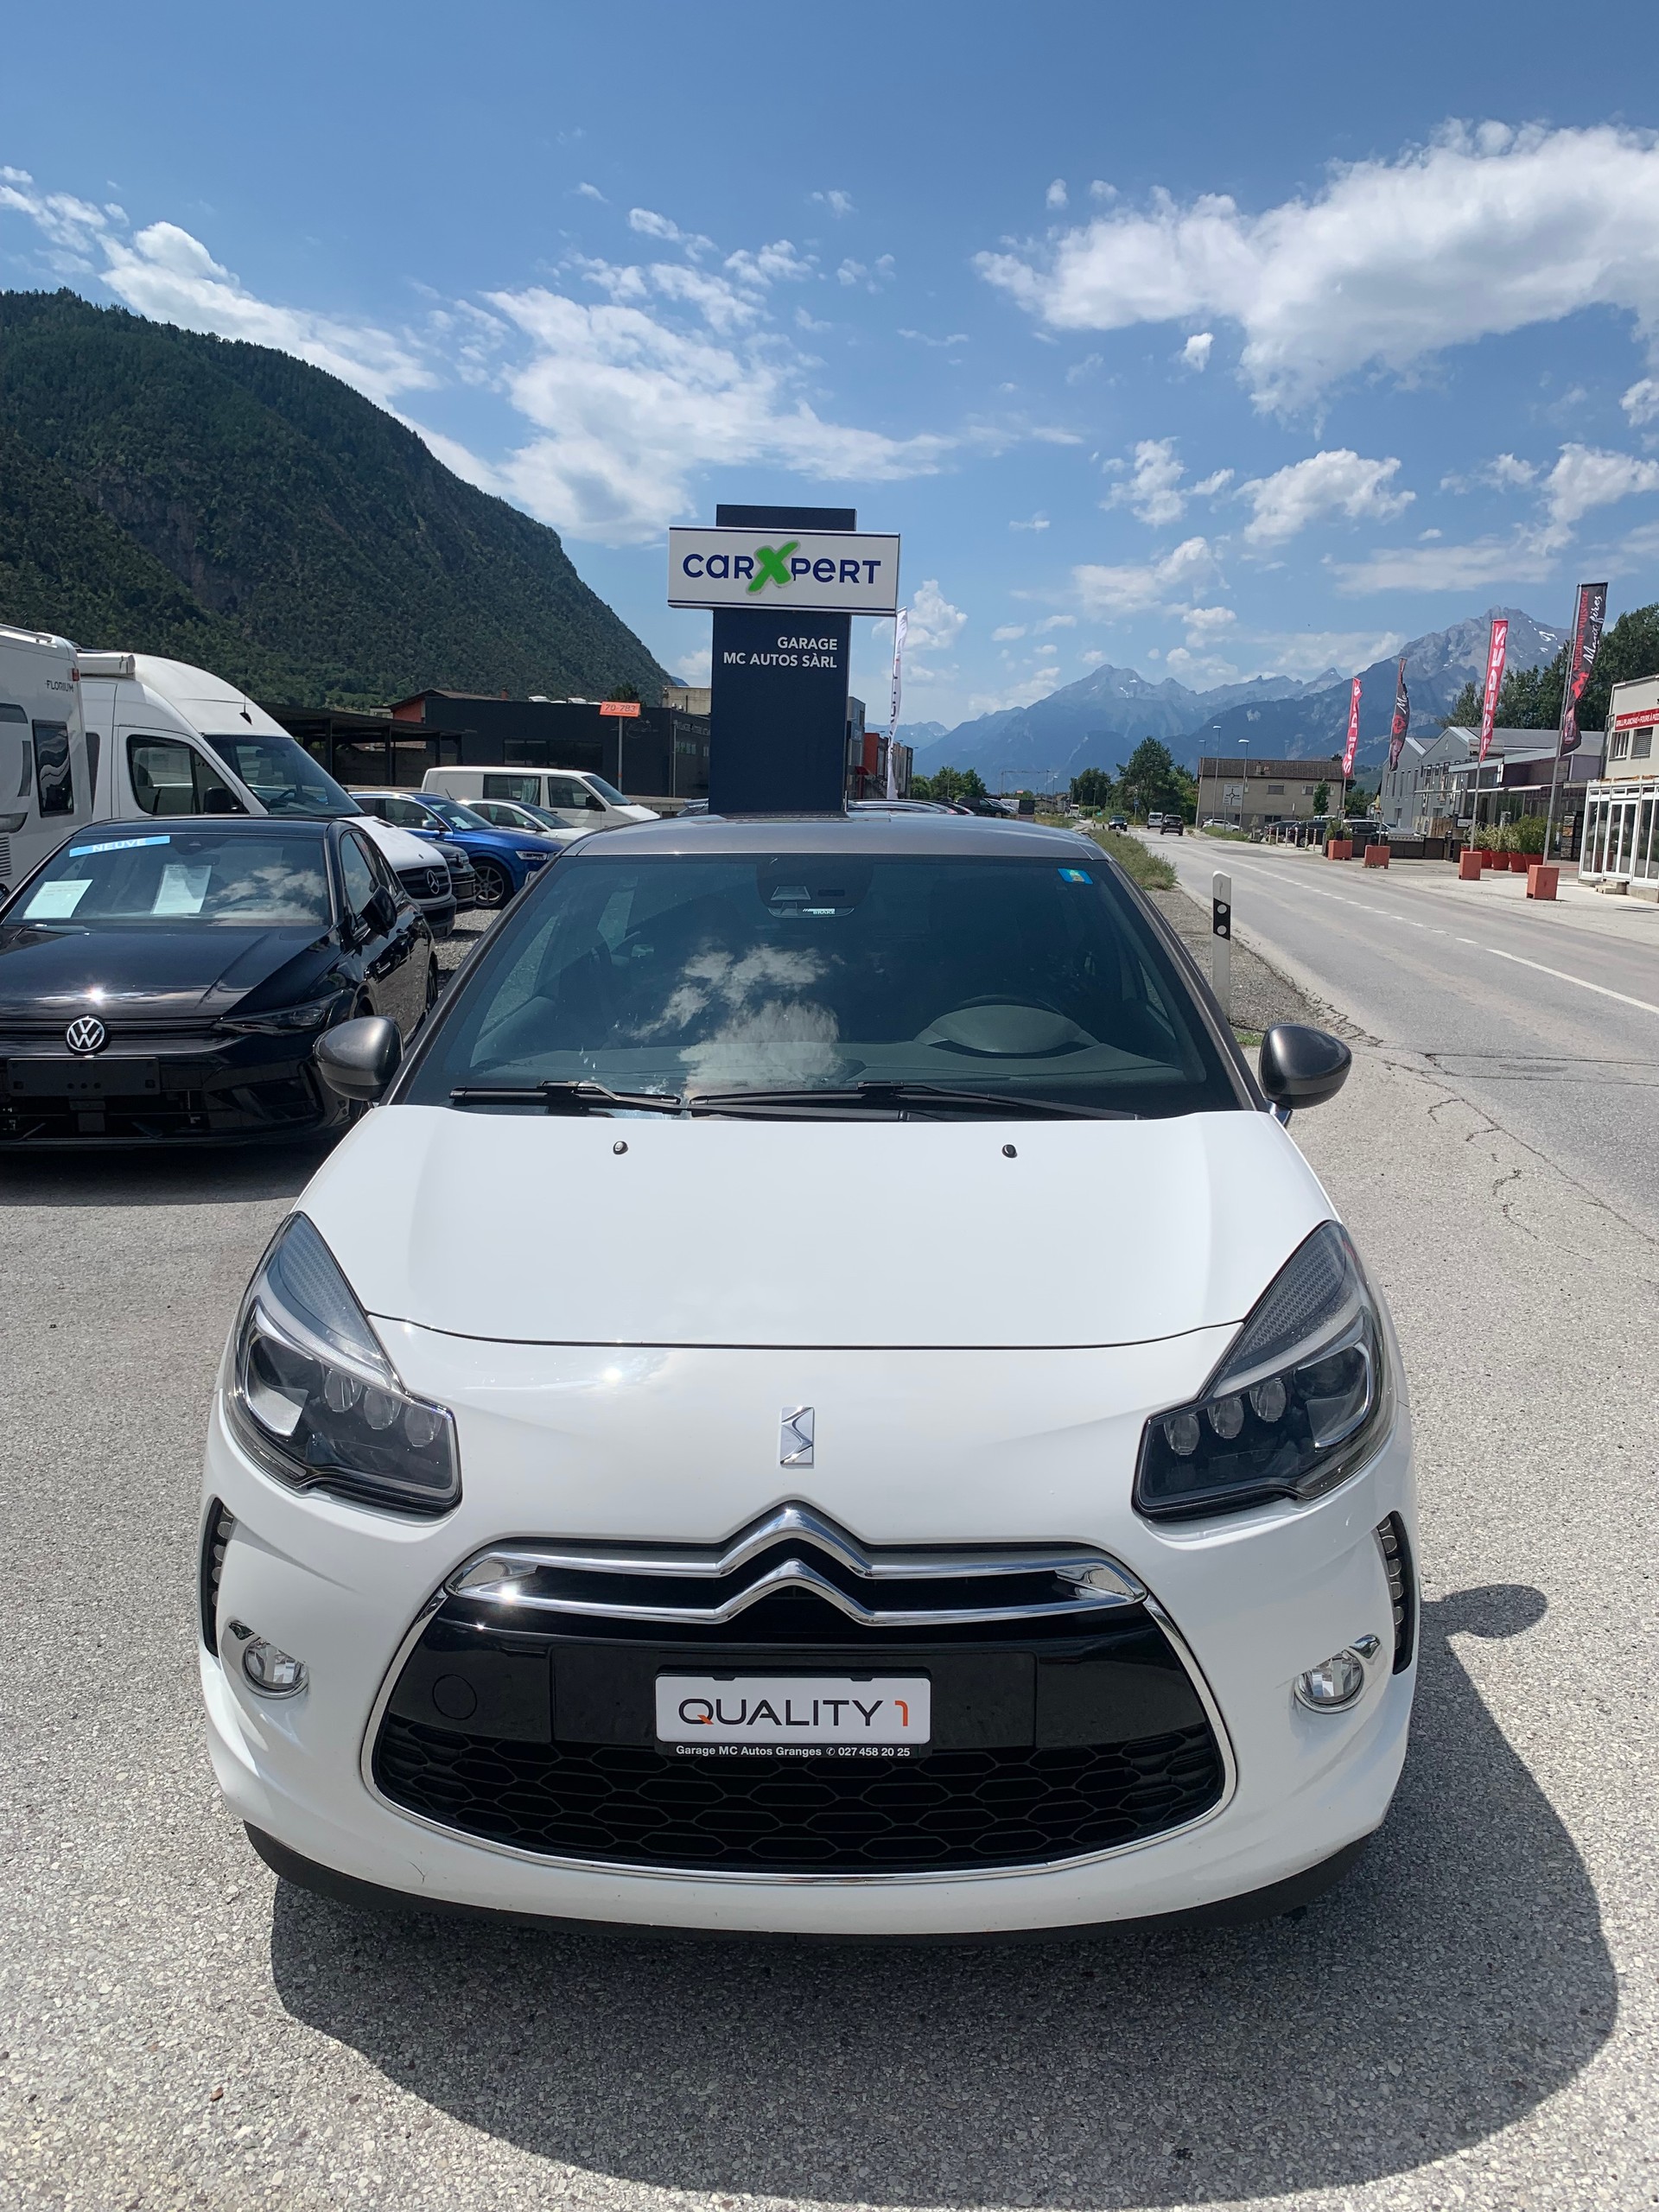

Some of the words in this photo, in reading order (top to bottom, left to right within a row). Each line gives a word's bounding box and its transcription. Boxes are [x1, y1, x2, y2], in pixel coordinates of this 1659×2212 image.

[777, 637, 838, 651] GARAGE
[723, 652, 747, 664] MC
[749, 653, 798, 666] AUTOS
[802, 652, 837, 668] SÀRL
[604, 703, 636, 713] 70-783
[92, 838, 146, 852] NEUVE
[678, 1698, 884, 1726] QUALITY
[894, 1700, 909, 1727] 1
[676, 1745, 716, 1757] Garage
[718, 1745, 738, 1756] MC
[741, 1745, 772, 1756] Autos
[775, 1745, 822, 1758] Granges
[837, 1746, 858, 1757] 027
[859, 1746, 879, 1757] 458
[881, 1746, 896, 1757] 20
[897, 1746, 911, 1757] 25
